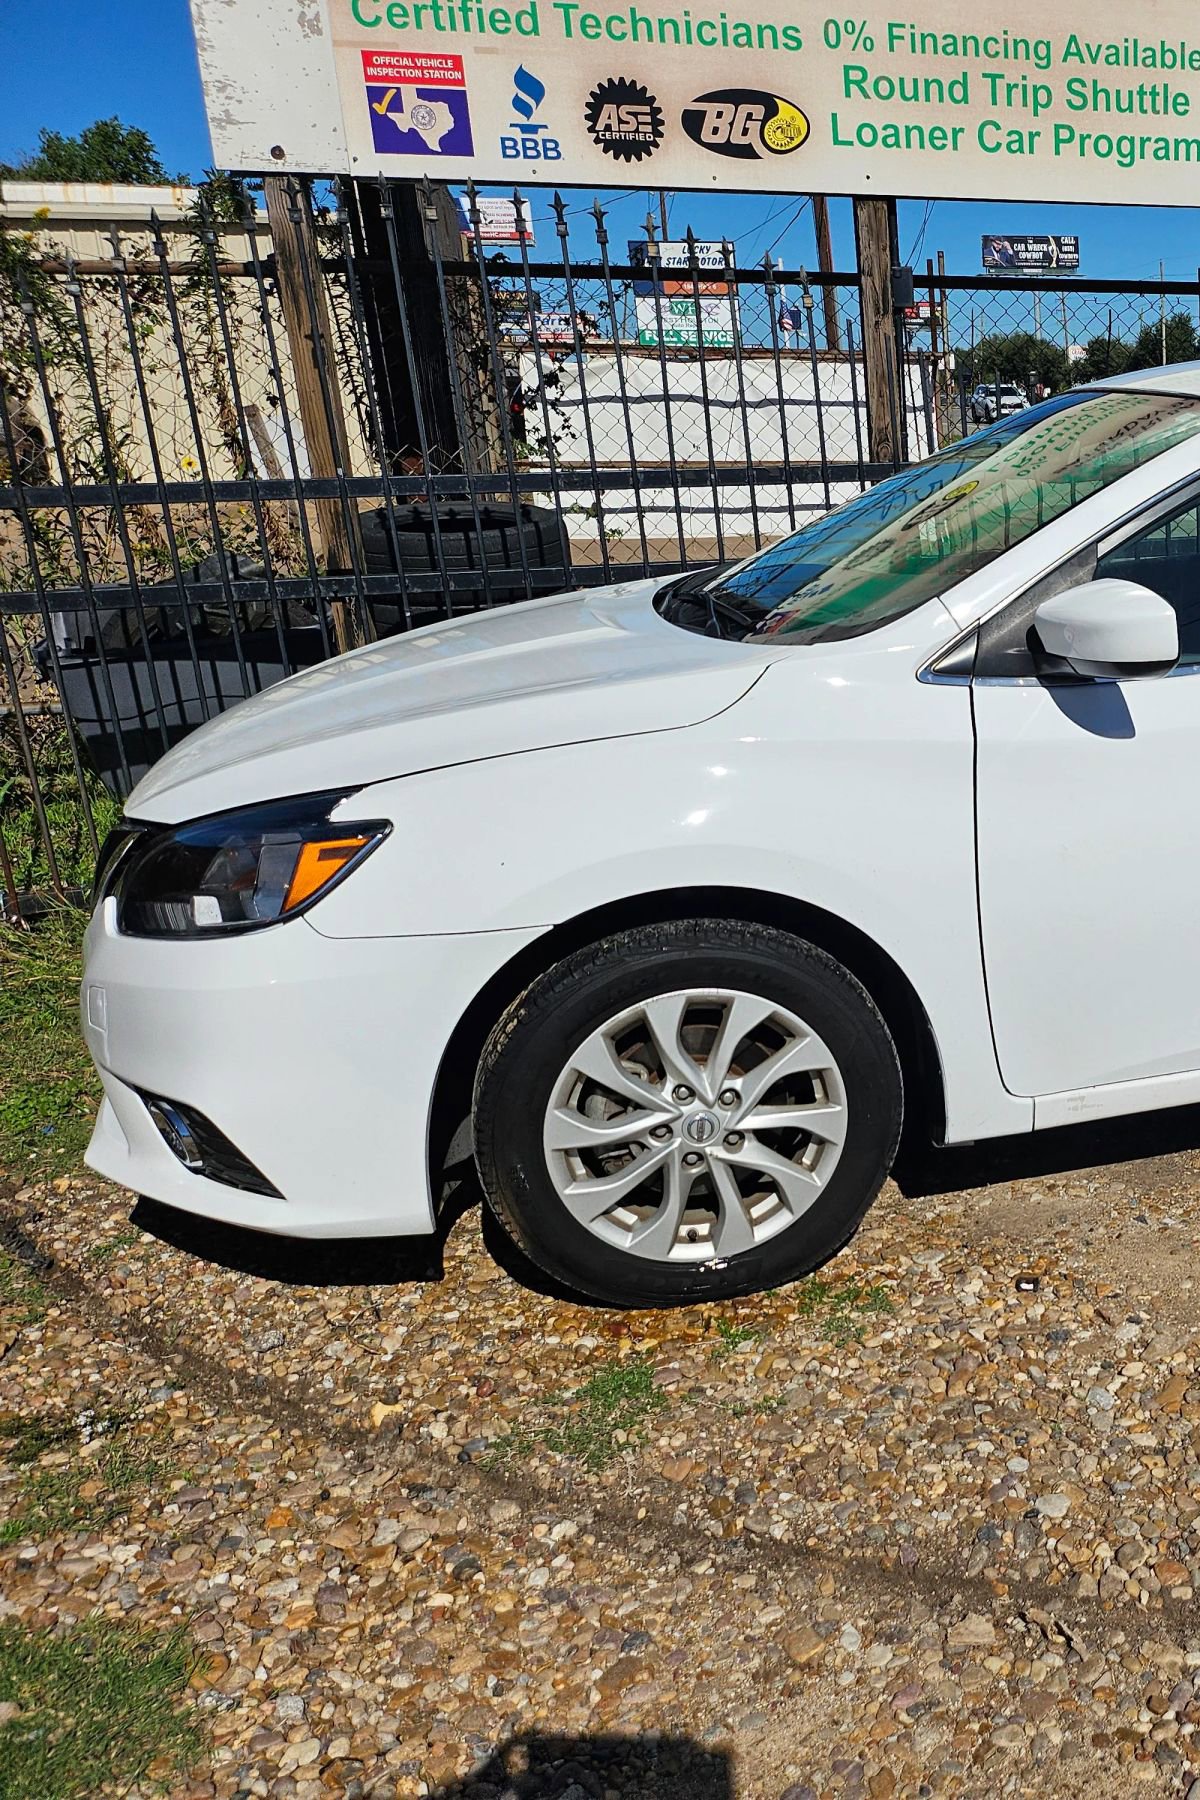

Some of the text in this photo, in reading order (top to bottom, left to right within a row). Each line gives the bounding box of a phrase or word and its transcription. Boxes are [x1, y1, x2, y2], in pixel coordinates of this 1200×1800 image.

[351, 0, 802, 53] Certified Technicians
[823, 18, 875, 53] 0%
[887, 22, 1052, 70] Financing
[366, 67, 462, 80] INSPECTION STATION
[372, 56, 454, 69] OFFICIAL VEHICLE
[842, 64, 1191, 117] Round Trip Shuttle
[594, 103, 653, 133] ASE
[699, 103, 766, 145] BG
[500, 136, 562, 161] BBB
[598, 131, 654, 141] CERTIFIED
[830, 112, 964, 152] Loaner
[976, 119, 1041, 155] Car
[1013, 243, 1025, 251] CAR
